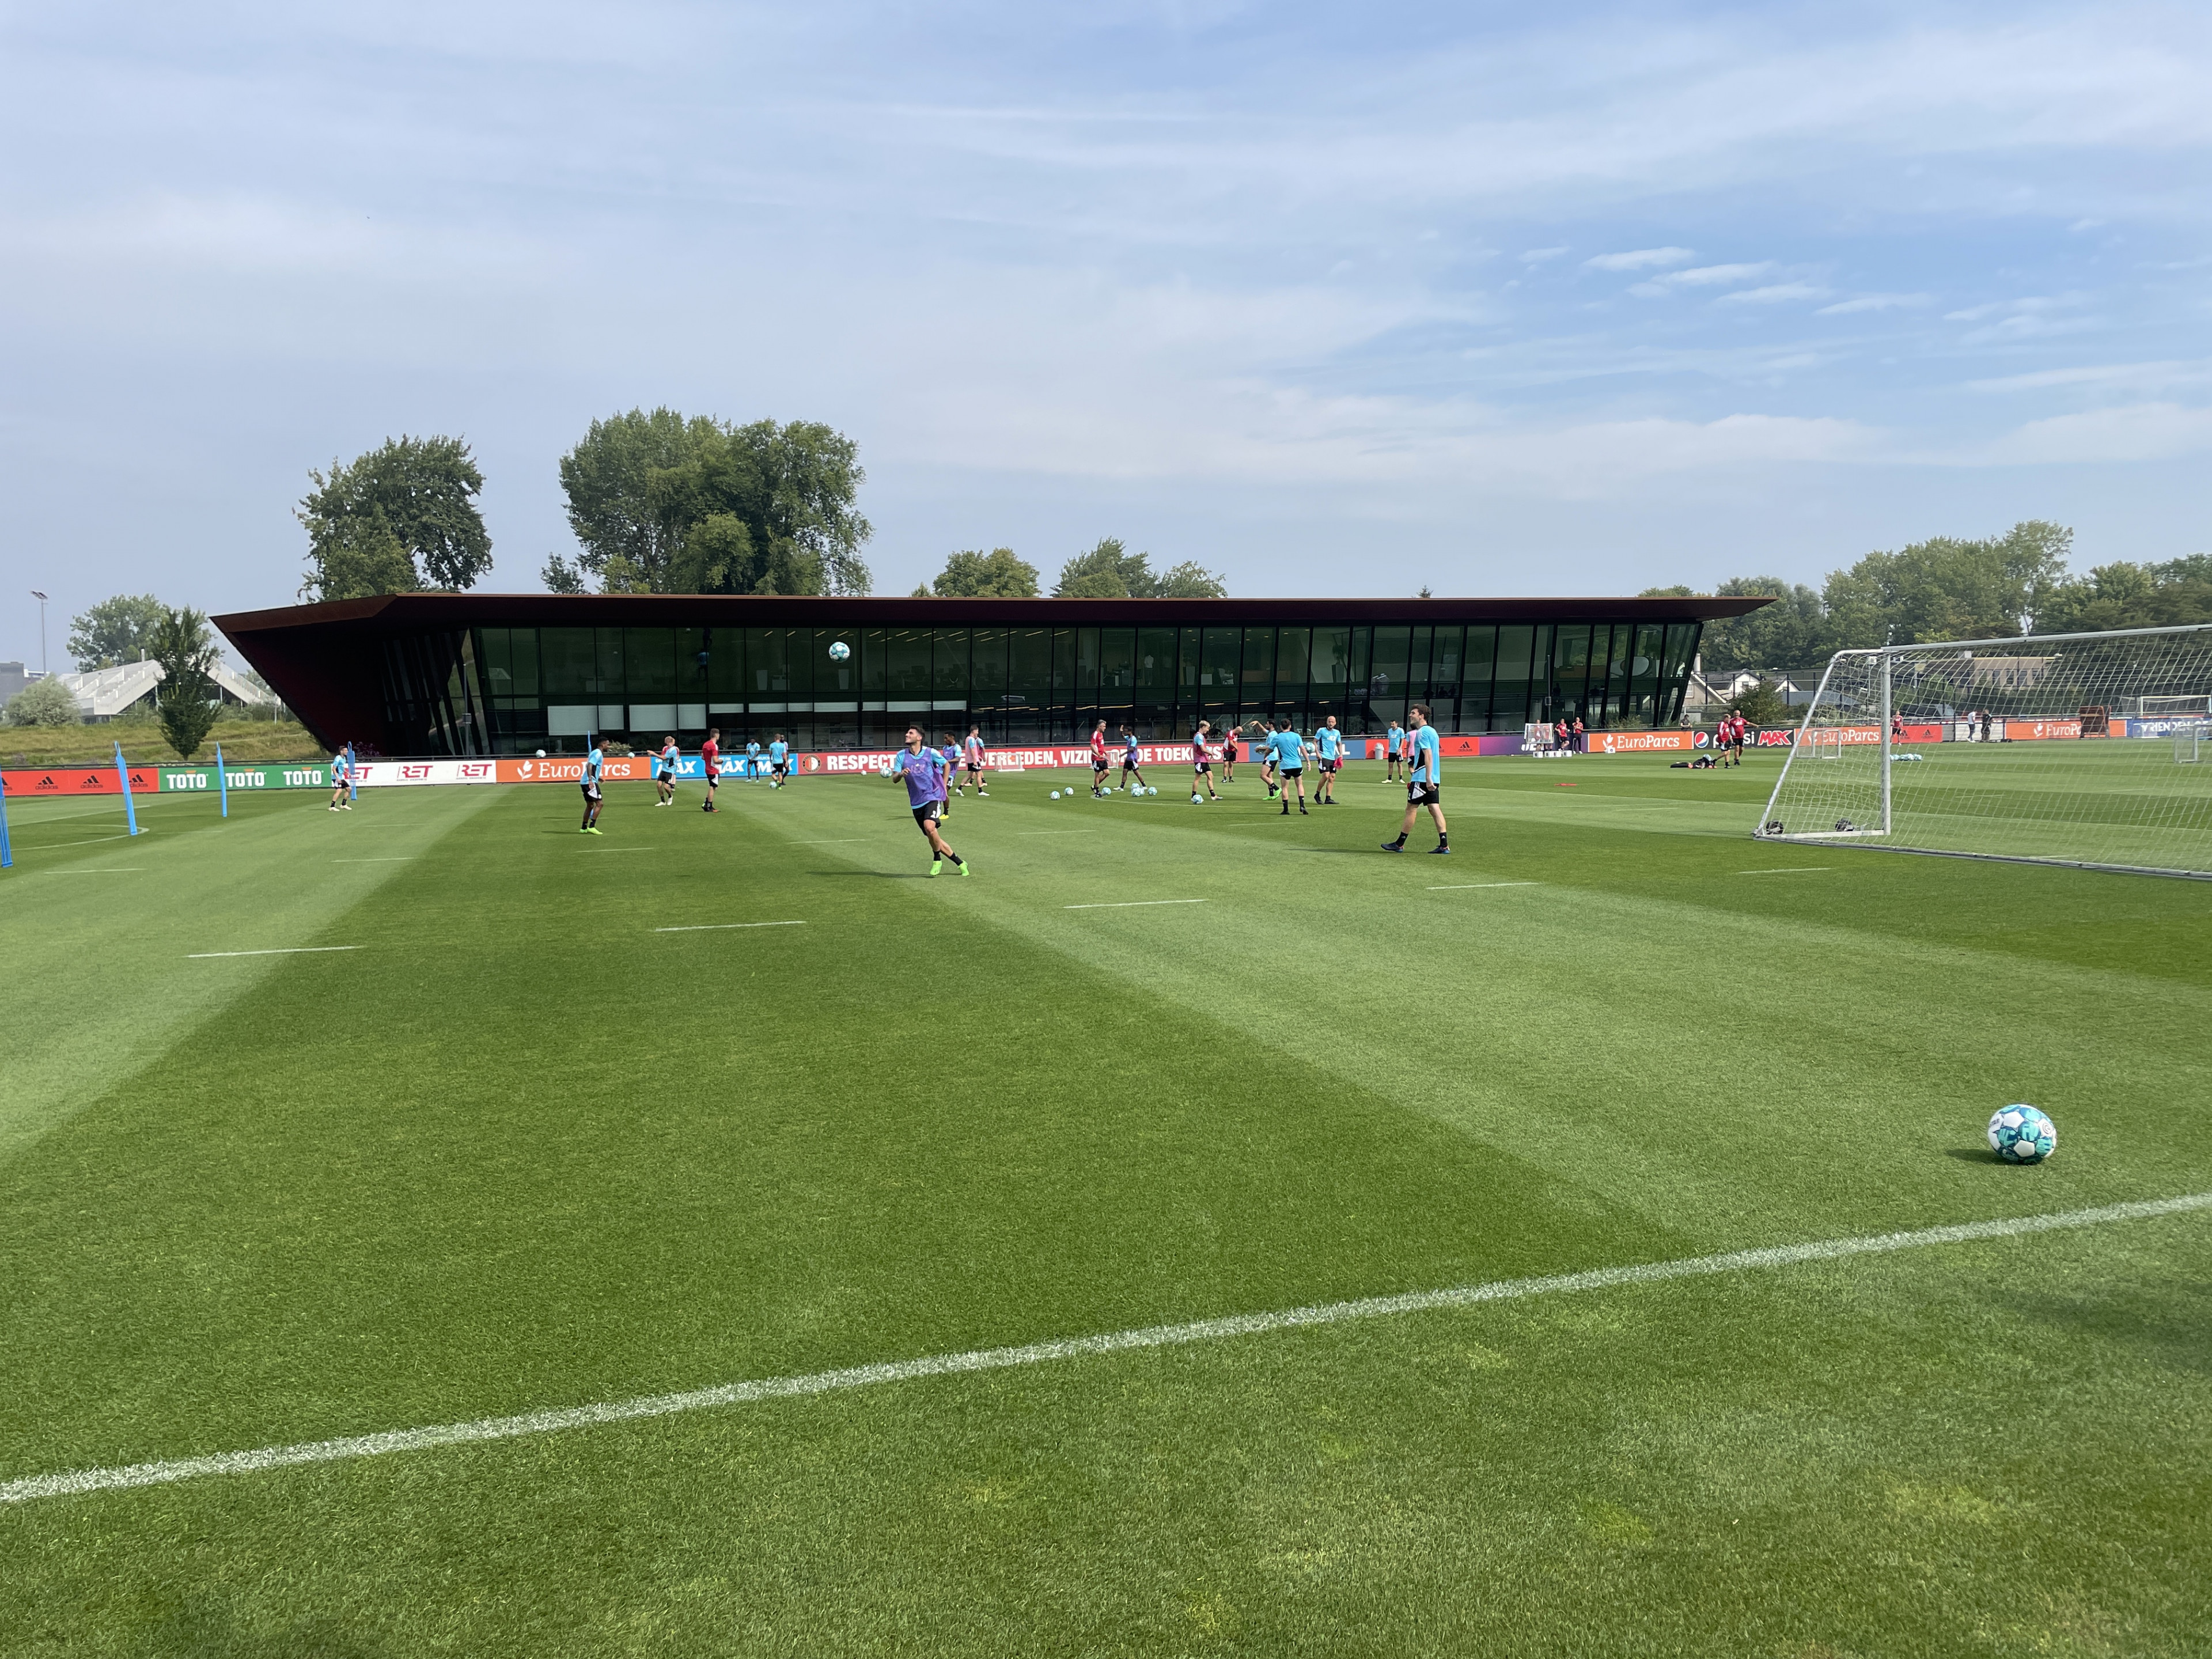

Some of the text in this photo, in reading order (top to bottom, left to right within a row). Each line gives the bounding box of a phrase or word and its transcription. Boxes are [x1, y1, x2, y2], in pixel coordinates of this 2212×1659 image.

[1617, 734, 1680, 749] EuroParcs
[1713, 730, 1793, 748] psi MAX
[1823, 729, 1880, 743] EuoParcs
[827, 753, 897, 771] RESPECT
[1060, 749, 1092, 764] VIZI
[1155, 746, 1224, 762] TOEKS
[402, 765, 433, 778] RET
[461, 764, 493, 777] RET
[539, 762, 631, 778] Eurorcs
[166, 770, 322, 789] TOTO TOTO TOTO
